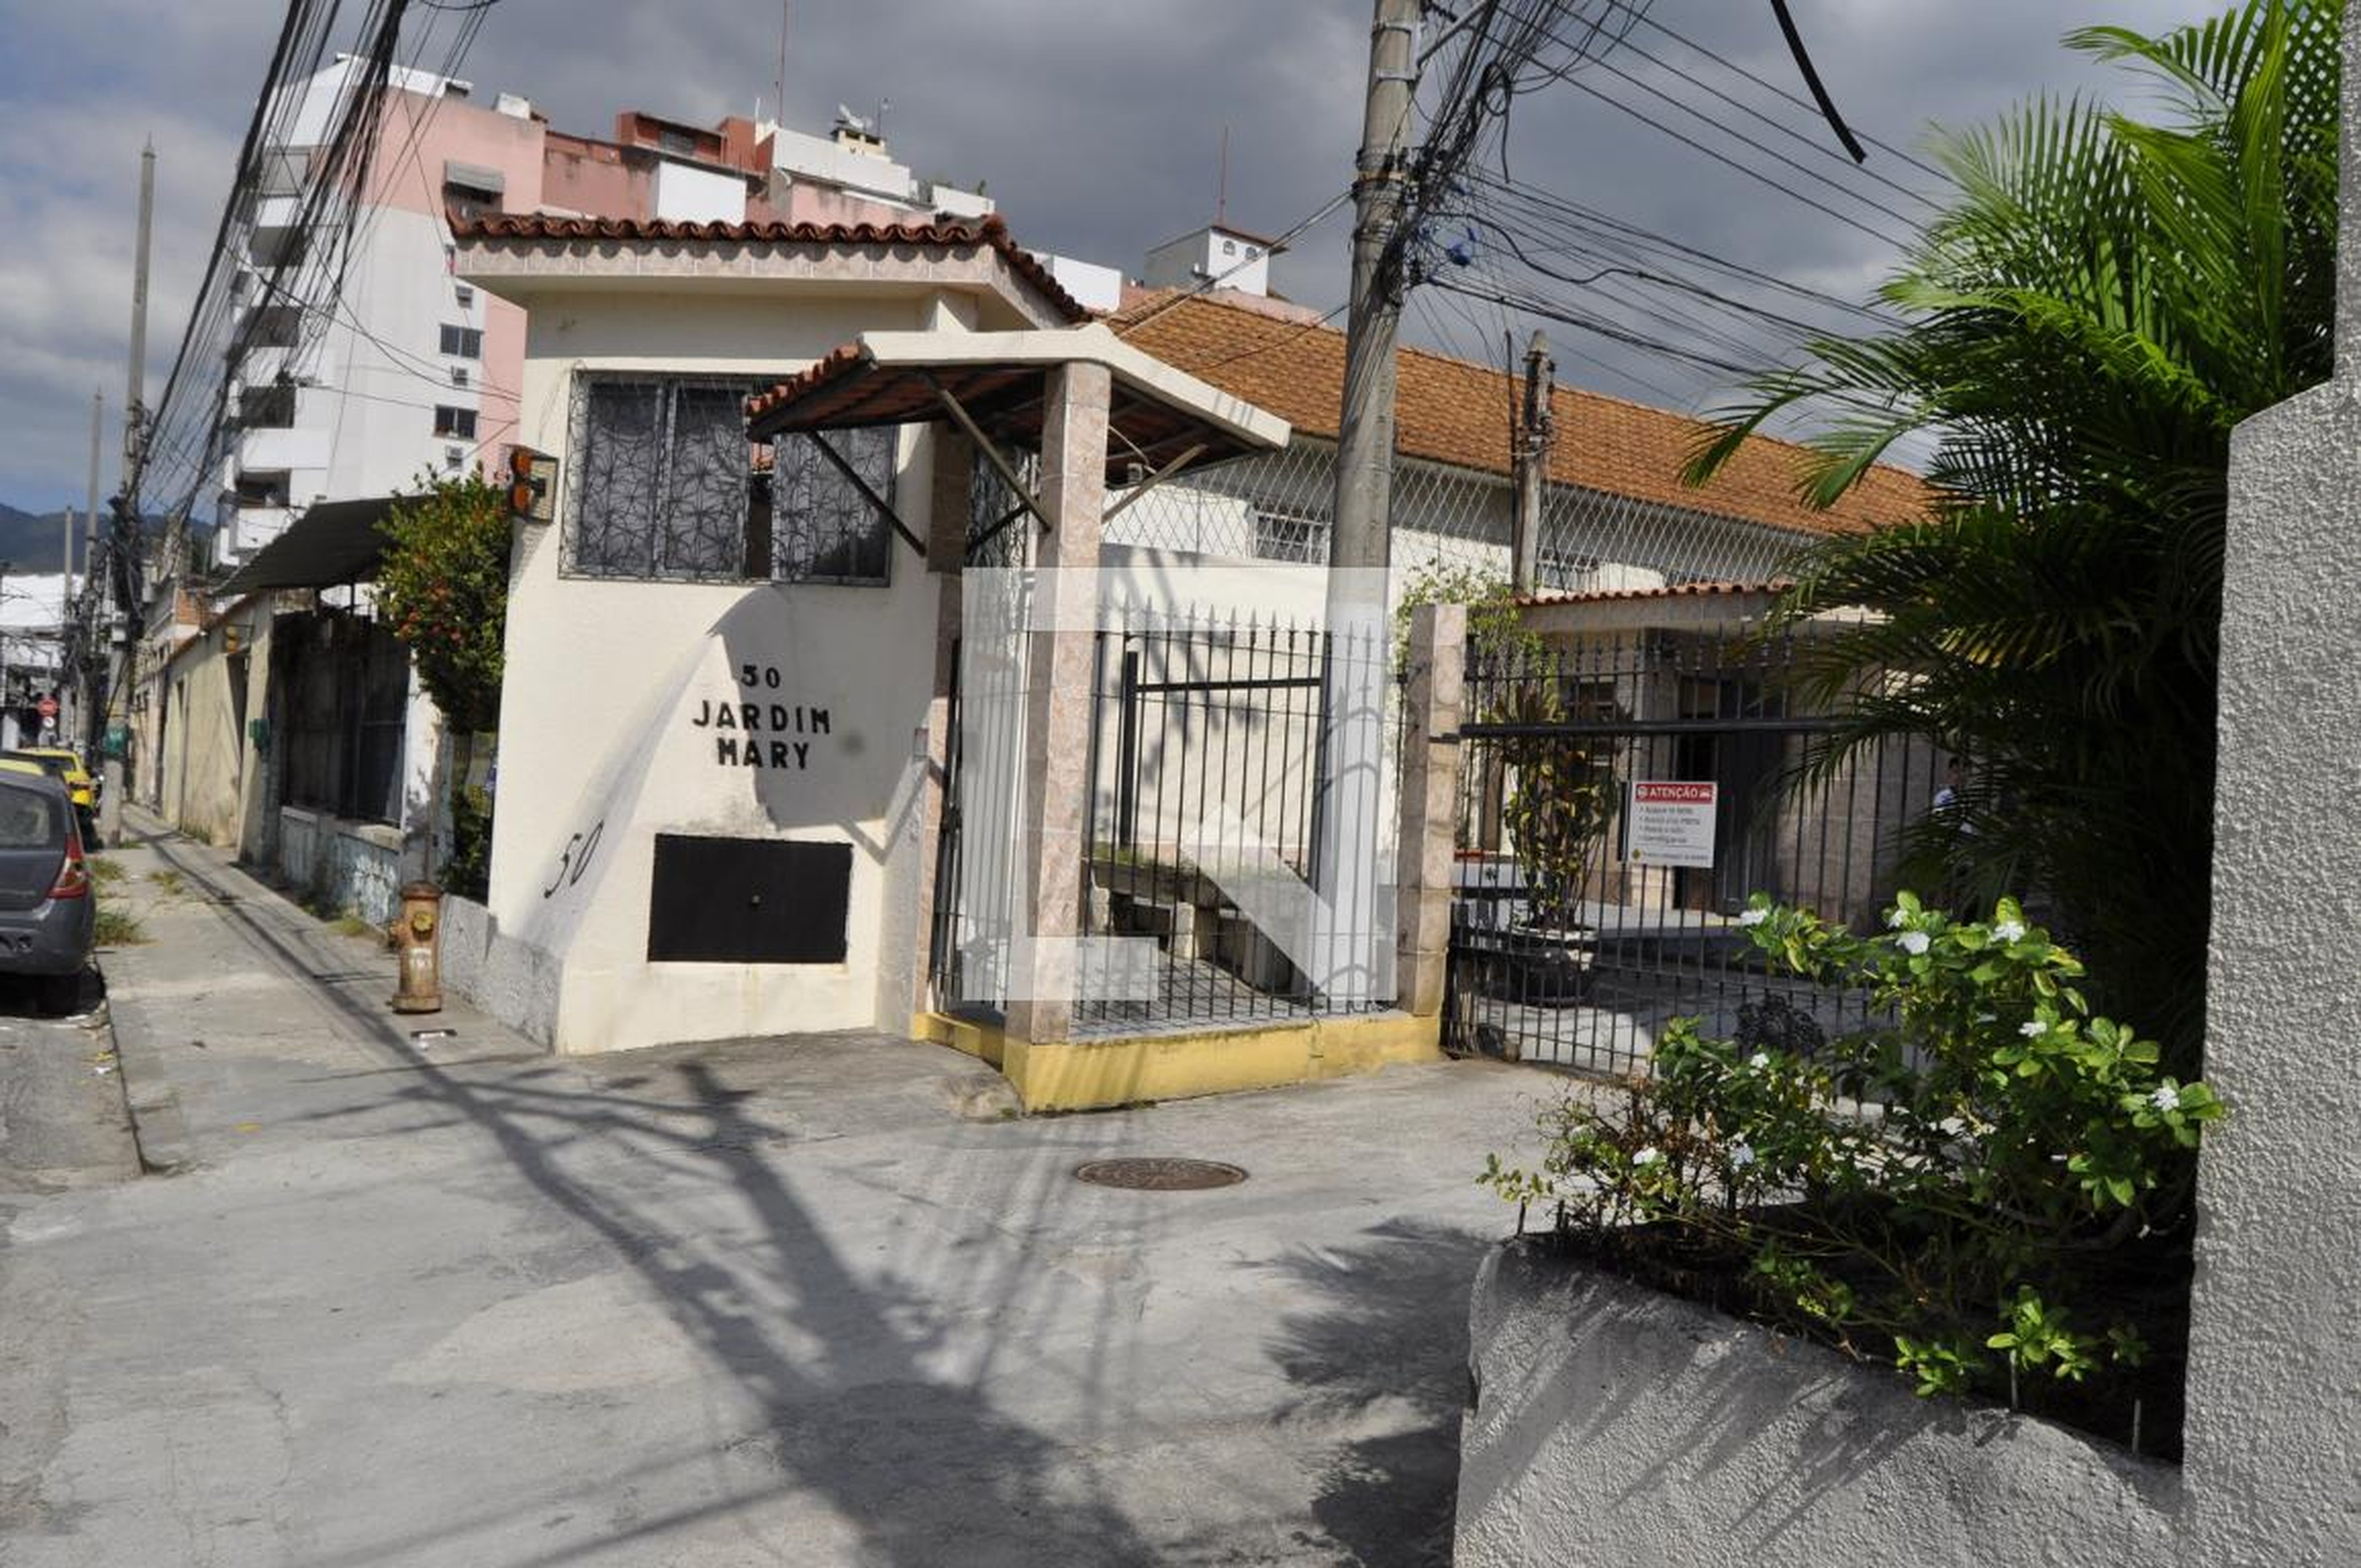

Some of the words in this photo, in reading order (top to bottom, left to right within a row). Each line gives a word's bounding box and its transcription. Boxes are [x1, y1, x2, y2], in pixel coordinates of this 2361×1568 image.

[741, 664, 781, 688] 50
[692, 699, 830, 734] JARDIM
[717, 737, 809, 770] MARY
[1649, 784, 1698, 798] ATENÇÃO
[544, 819, 604, 899] 50
